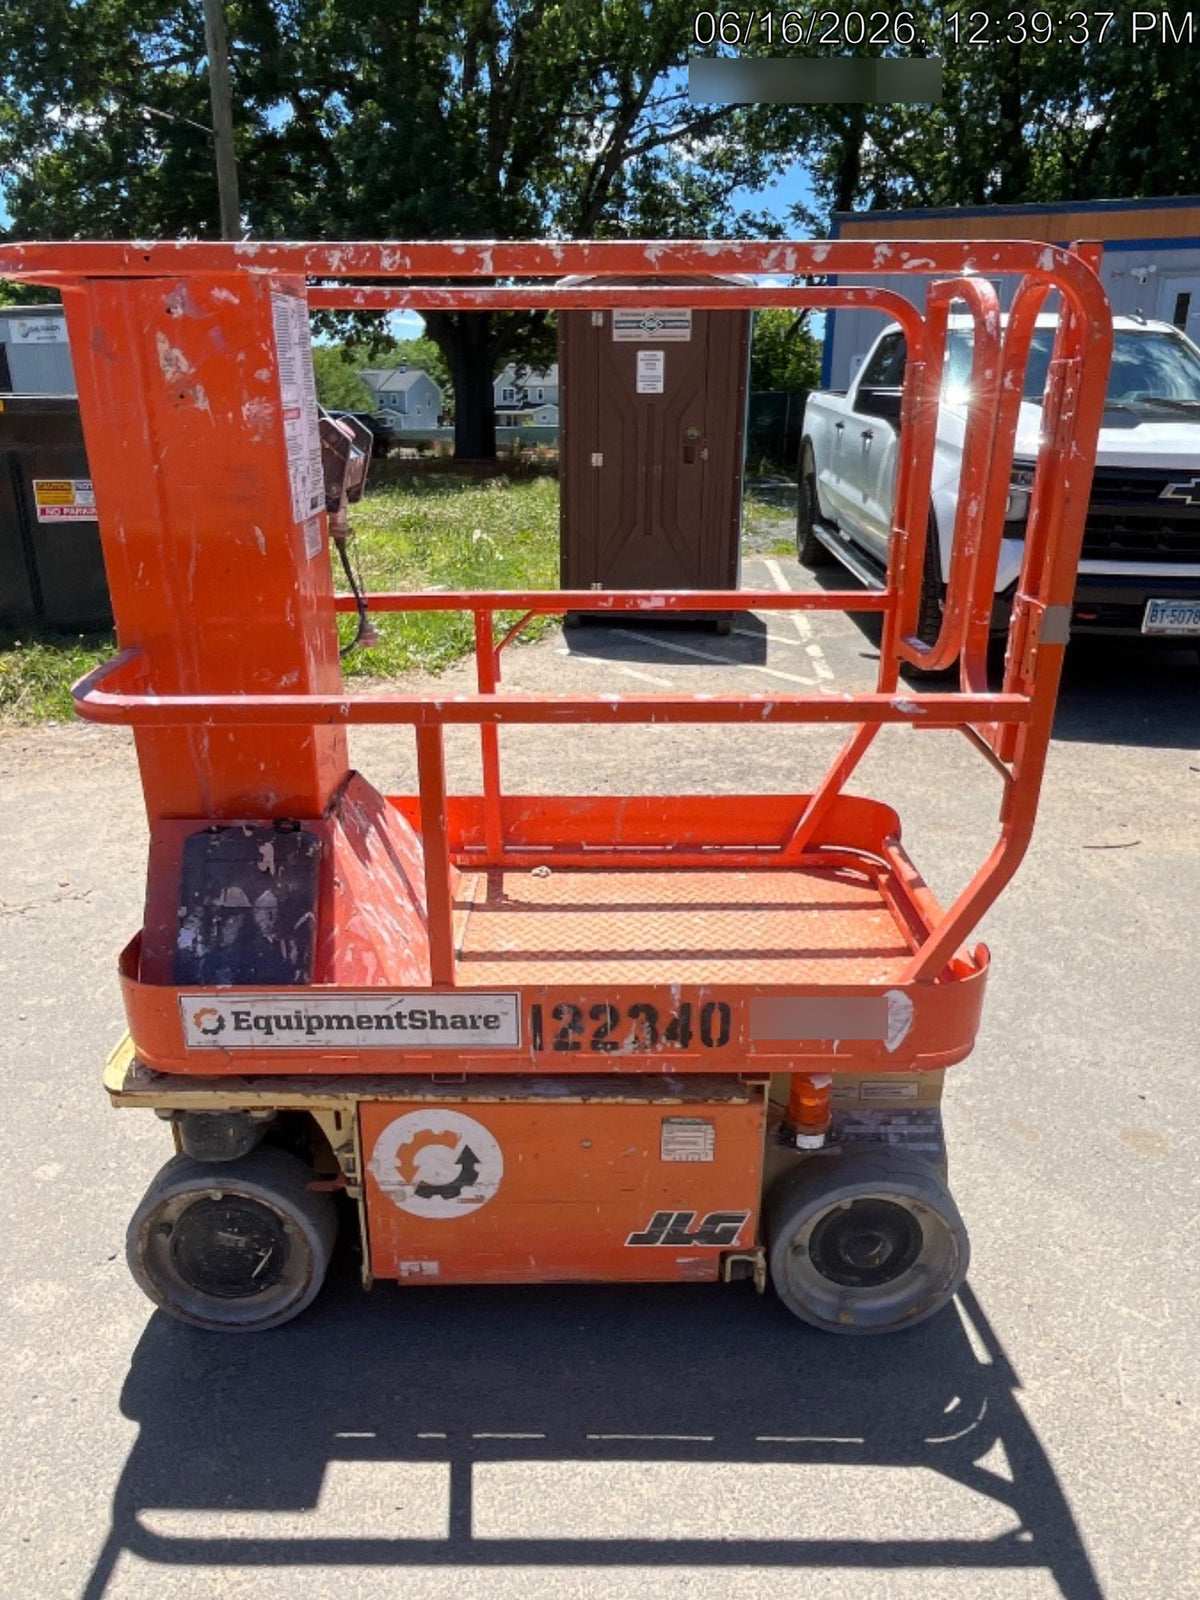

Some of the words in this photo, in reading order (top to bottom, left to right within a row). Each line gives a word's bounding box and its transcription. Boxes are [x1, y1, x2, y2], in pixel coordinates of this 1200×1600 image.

[45, 507, 60, 516] NO
[63, 507, 98, 516] PARKIN
[231, 1007, 501, 1035] EquipmentShare
[531, 1001, 732, 1052] 122340
[624, 1210, 752, 1247] JLG
